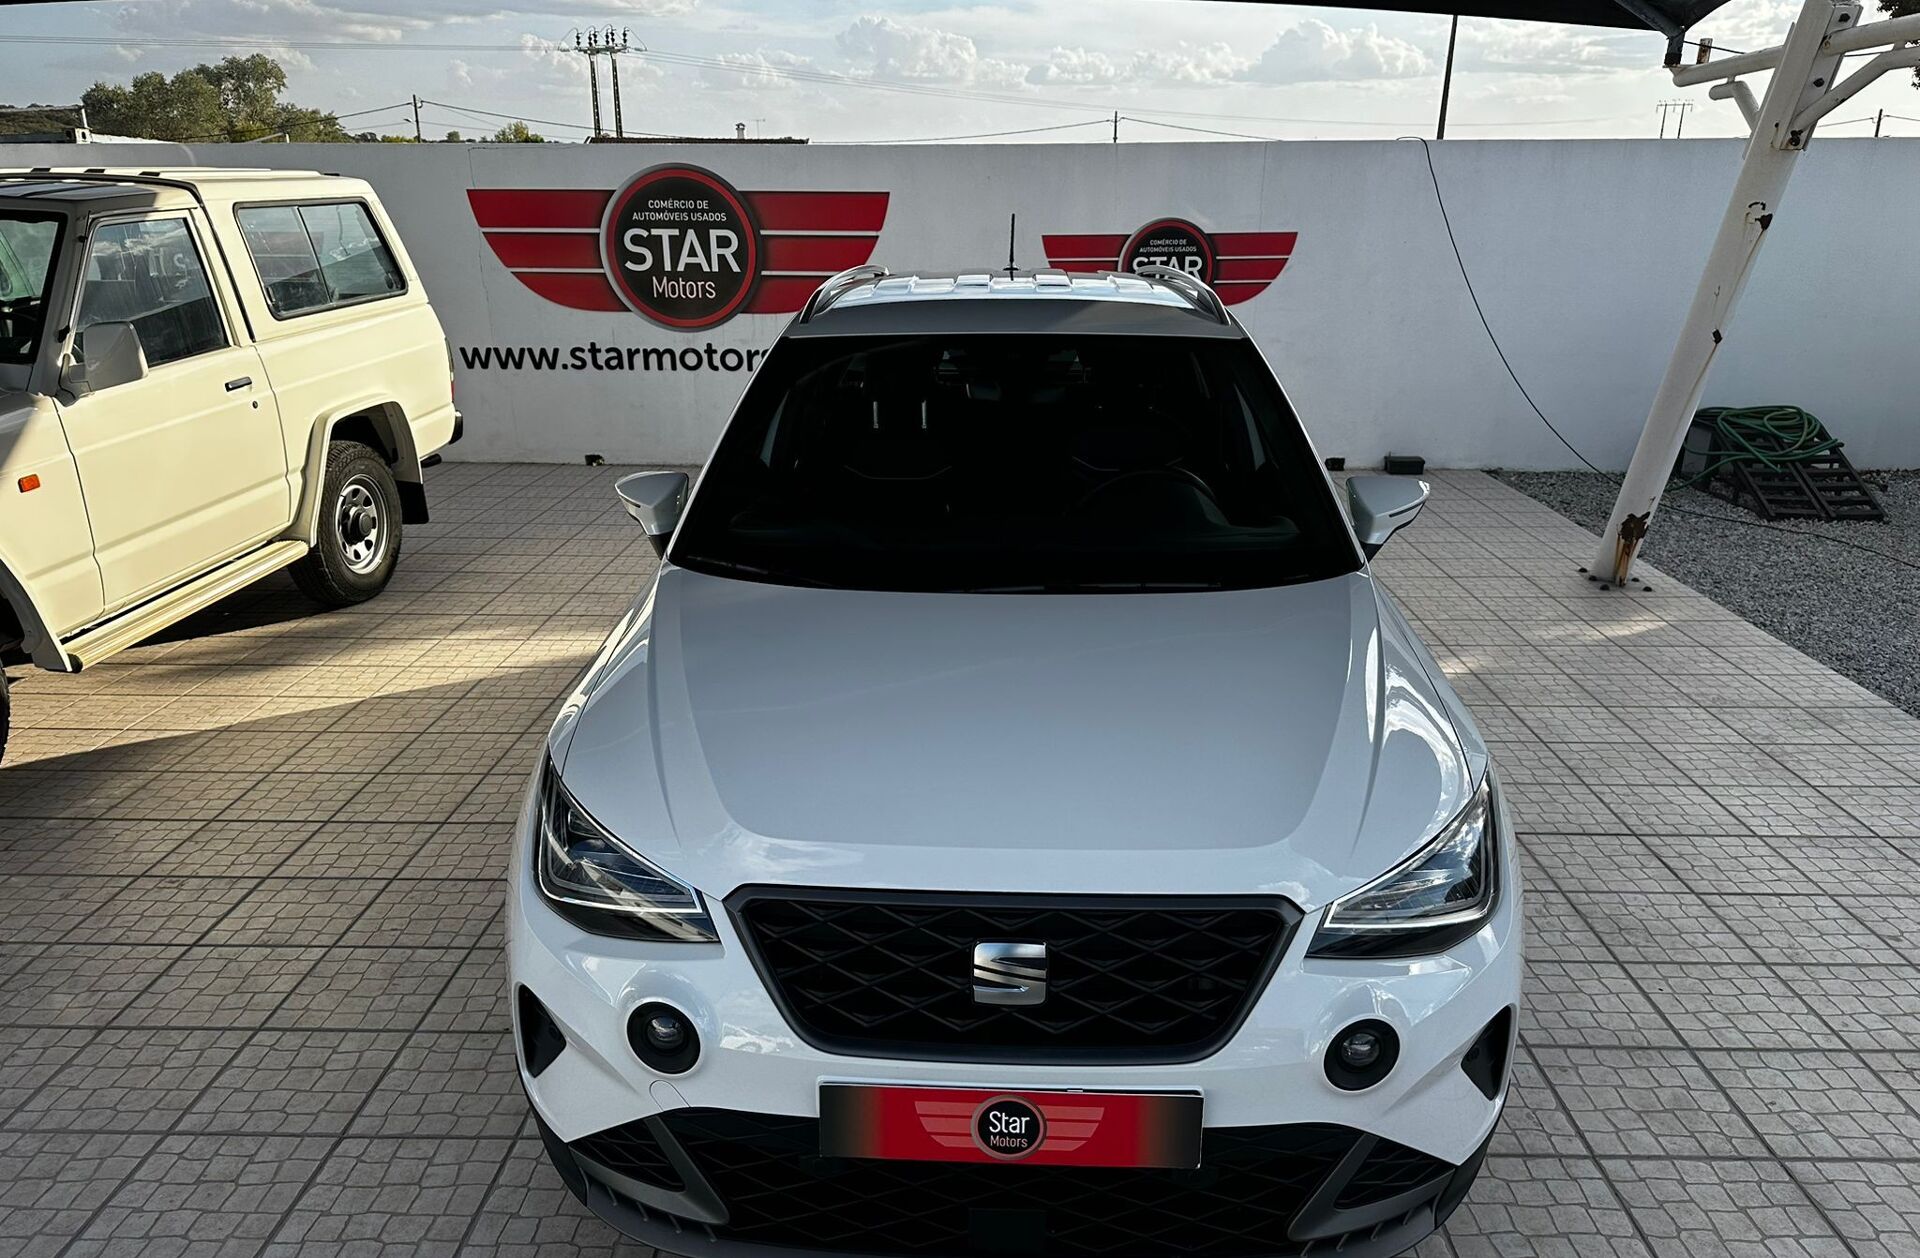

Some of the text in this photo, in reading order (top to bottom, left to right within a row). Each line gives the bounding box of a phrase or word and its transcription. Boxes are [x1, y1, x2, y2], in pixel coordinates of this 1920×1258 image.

[648, 198, 709, 209] COMÉRCIO DE
[632, 210, 727, 222] AUTOMÓVEIS USADOS
[623, 228, 742, 272] STAR
[652, 276, 716, 299] Motors
[989, 1111, 1030, 1134] Star
[990, 1135, 1028, 1148] Motors
